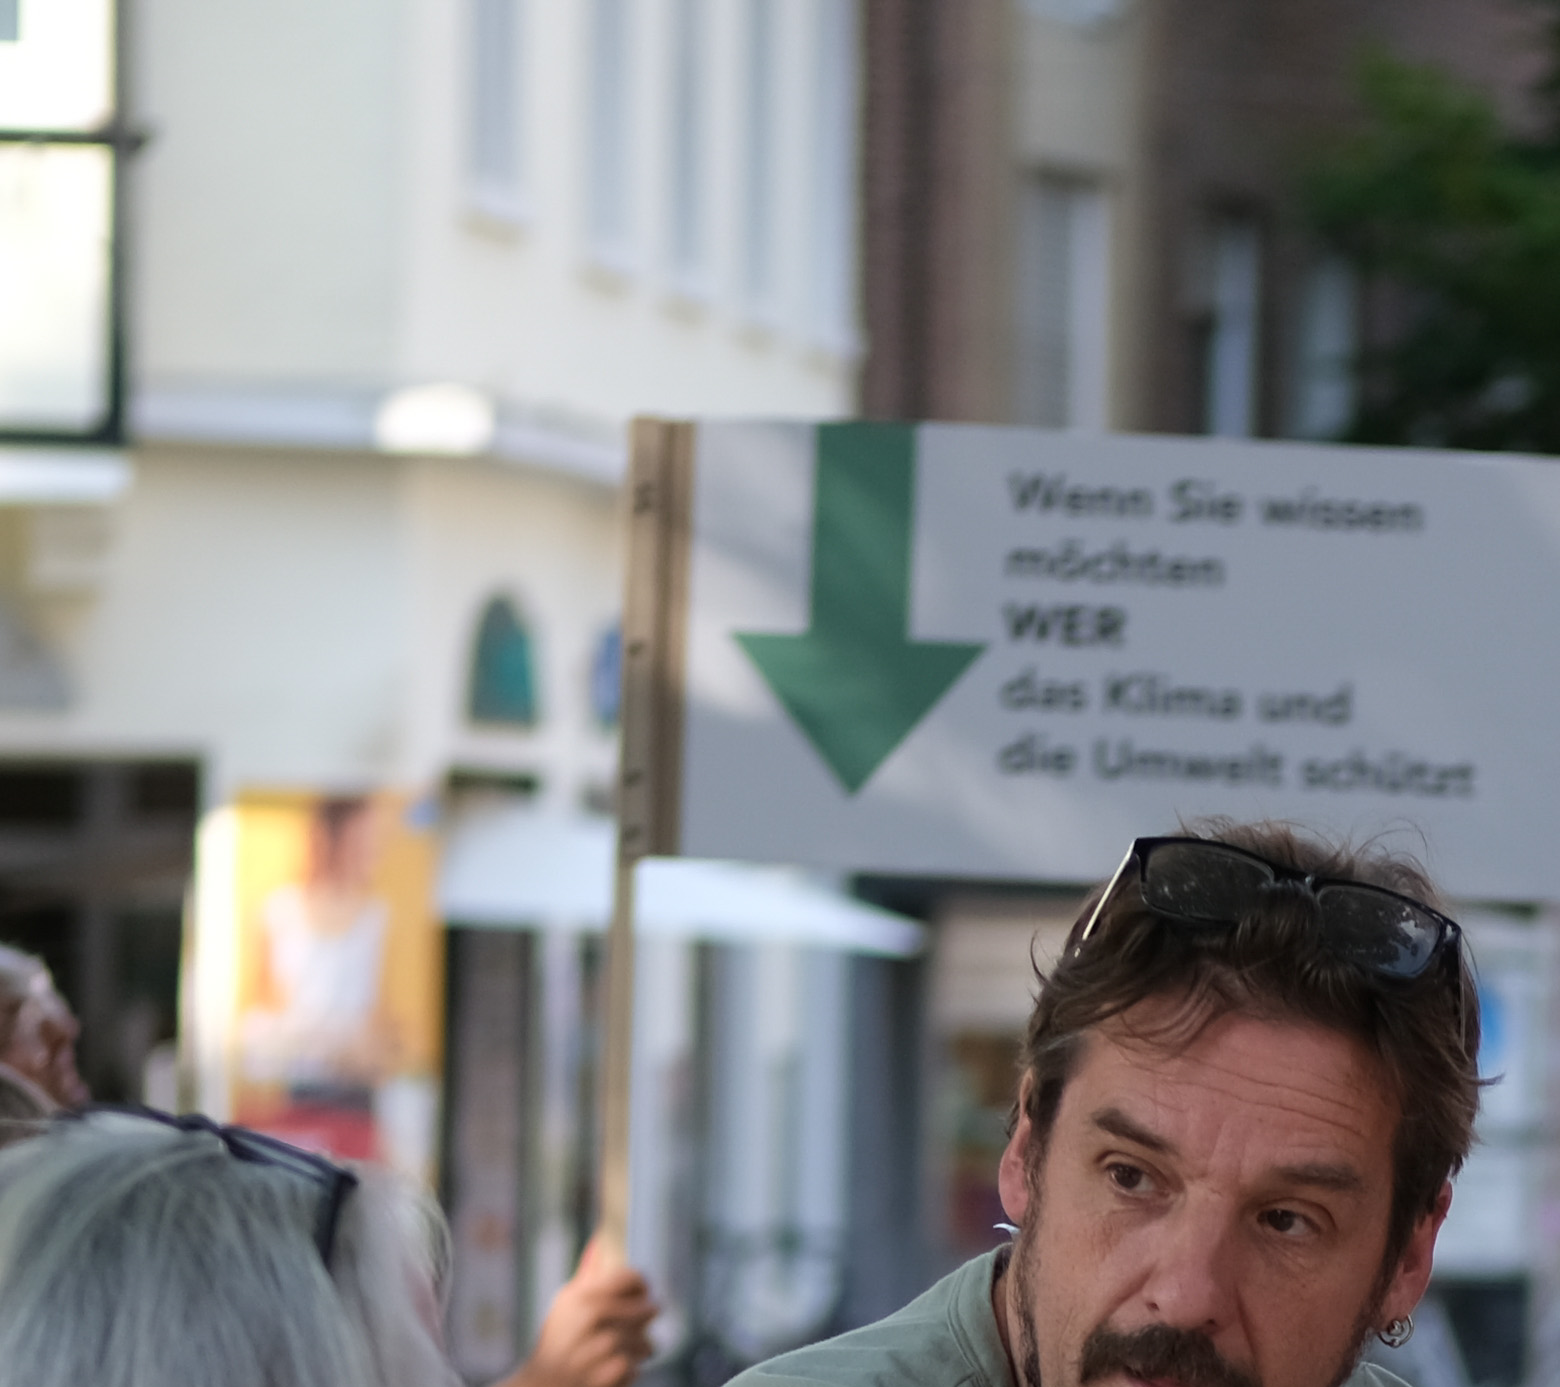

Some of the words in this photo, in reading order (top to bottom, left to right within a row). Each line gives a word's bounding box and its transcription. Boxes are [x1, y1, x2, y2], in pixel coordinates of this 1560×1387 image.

[1006, 467, 1155, 524] Wenn
[1169, 475, 1244, 528] Sie
[1257, 485, 1425, 537] wissen
[1003, 537, 1227, 592] möchten
[1004, 602, 1128, 648] WER
[1000, 667, 1089, 716] das
[1103, 670, 1243, 721] Klima
[1258, 682, 1354, 729] und
[997, 733, 1077, 782] die
[1092, 737, 1284, 790] Umwelt
[1302, 748, 1478, 800] schützt
